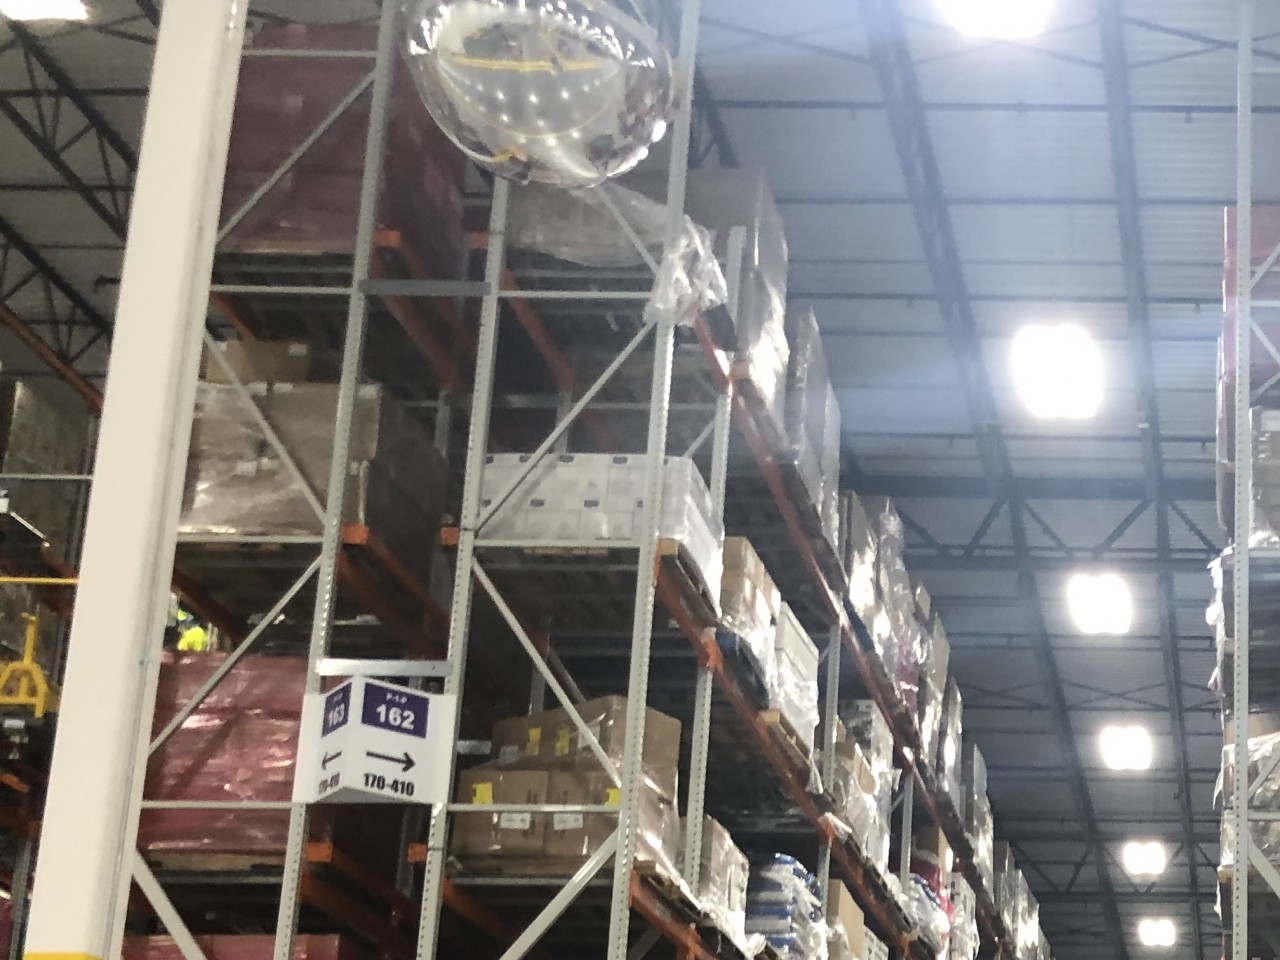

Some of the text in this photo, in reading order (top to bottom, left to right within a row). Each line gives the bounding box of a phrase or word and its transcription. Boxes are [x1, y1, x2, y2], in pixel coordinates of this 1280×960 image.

[328, 703, 345, 728] 163
[376, 704, 415, 730] 162
[364, 773, 415, 797] 170-410
